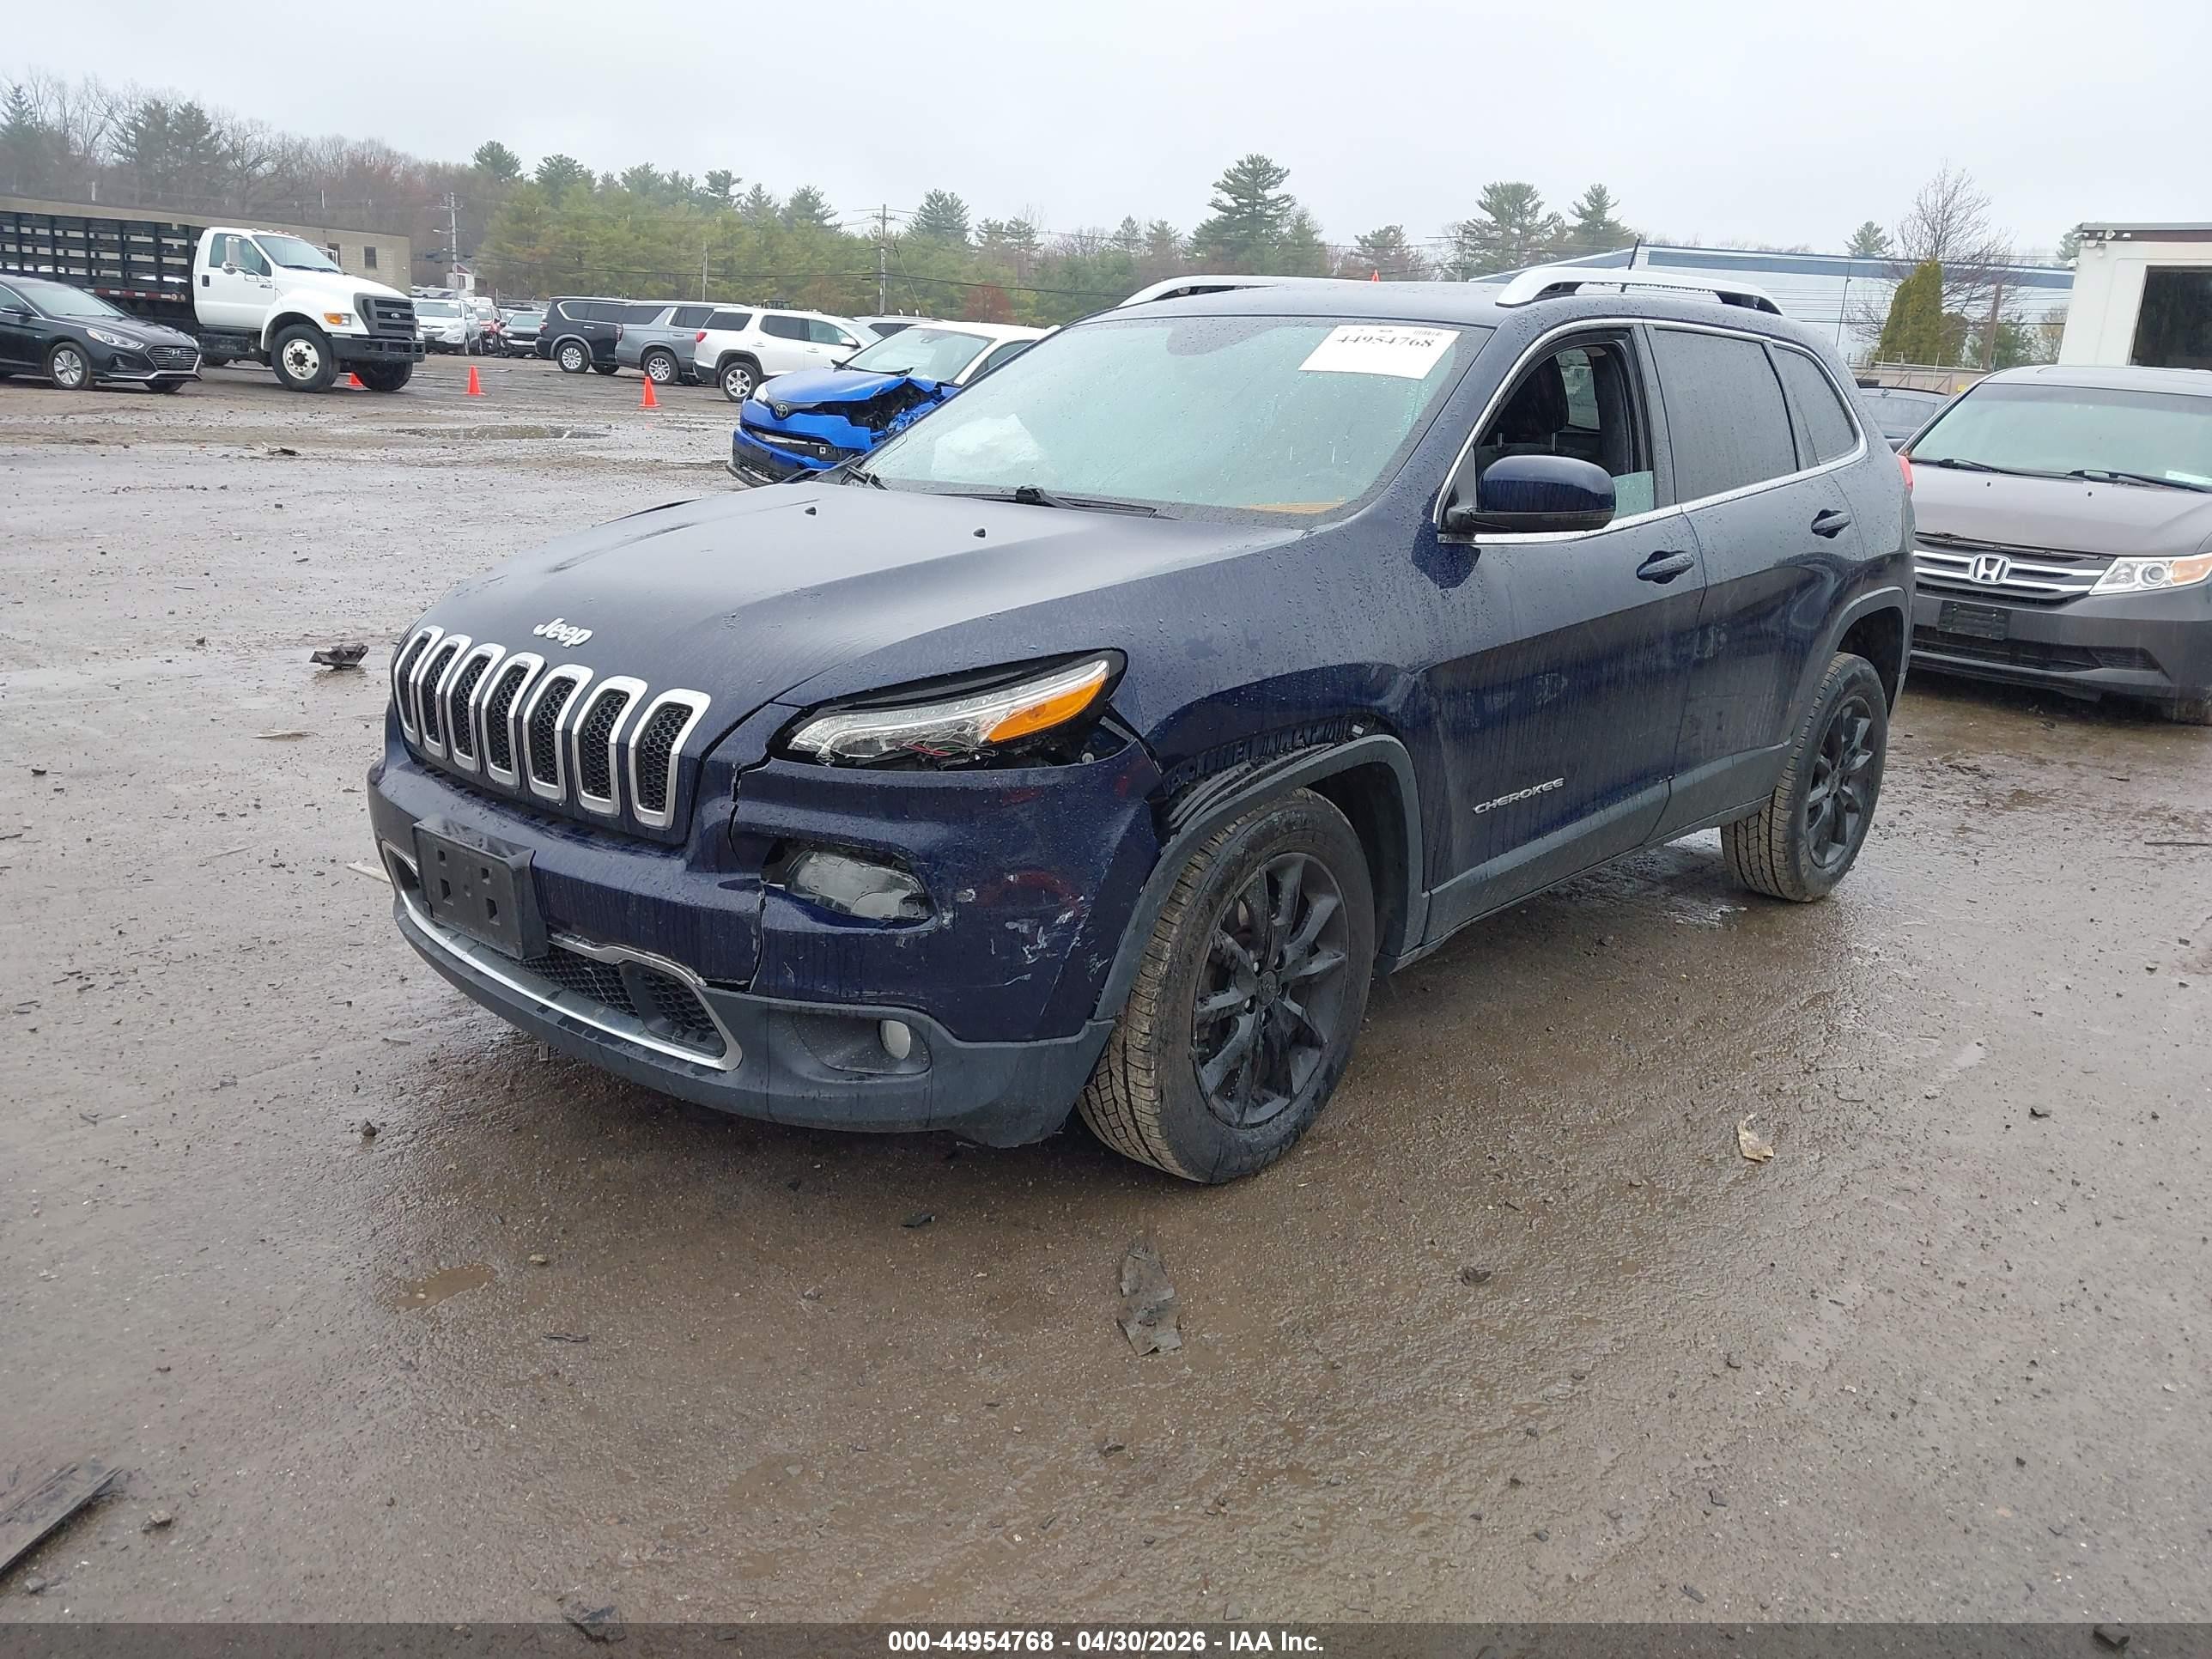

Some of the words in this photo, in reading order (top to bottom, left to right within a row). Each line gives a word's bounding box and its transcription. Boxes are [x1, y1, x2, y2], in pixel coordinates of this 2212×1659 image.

[1336, 334, 1435, 348] 44954768
[533, 617, 593, 648] Jeep
[1474, 777, 1565, 814] CHEROKEE
